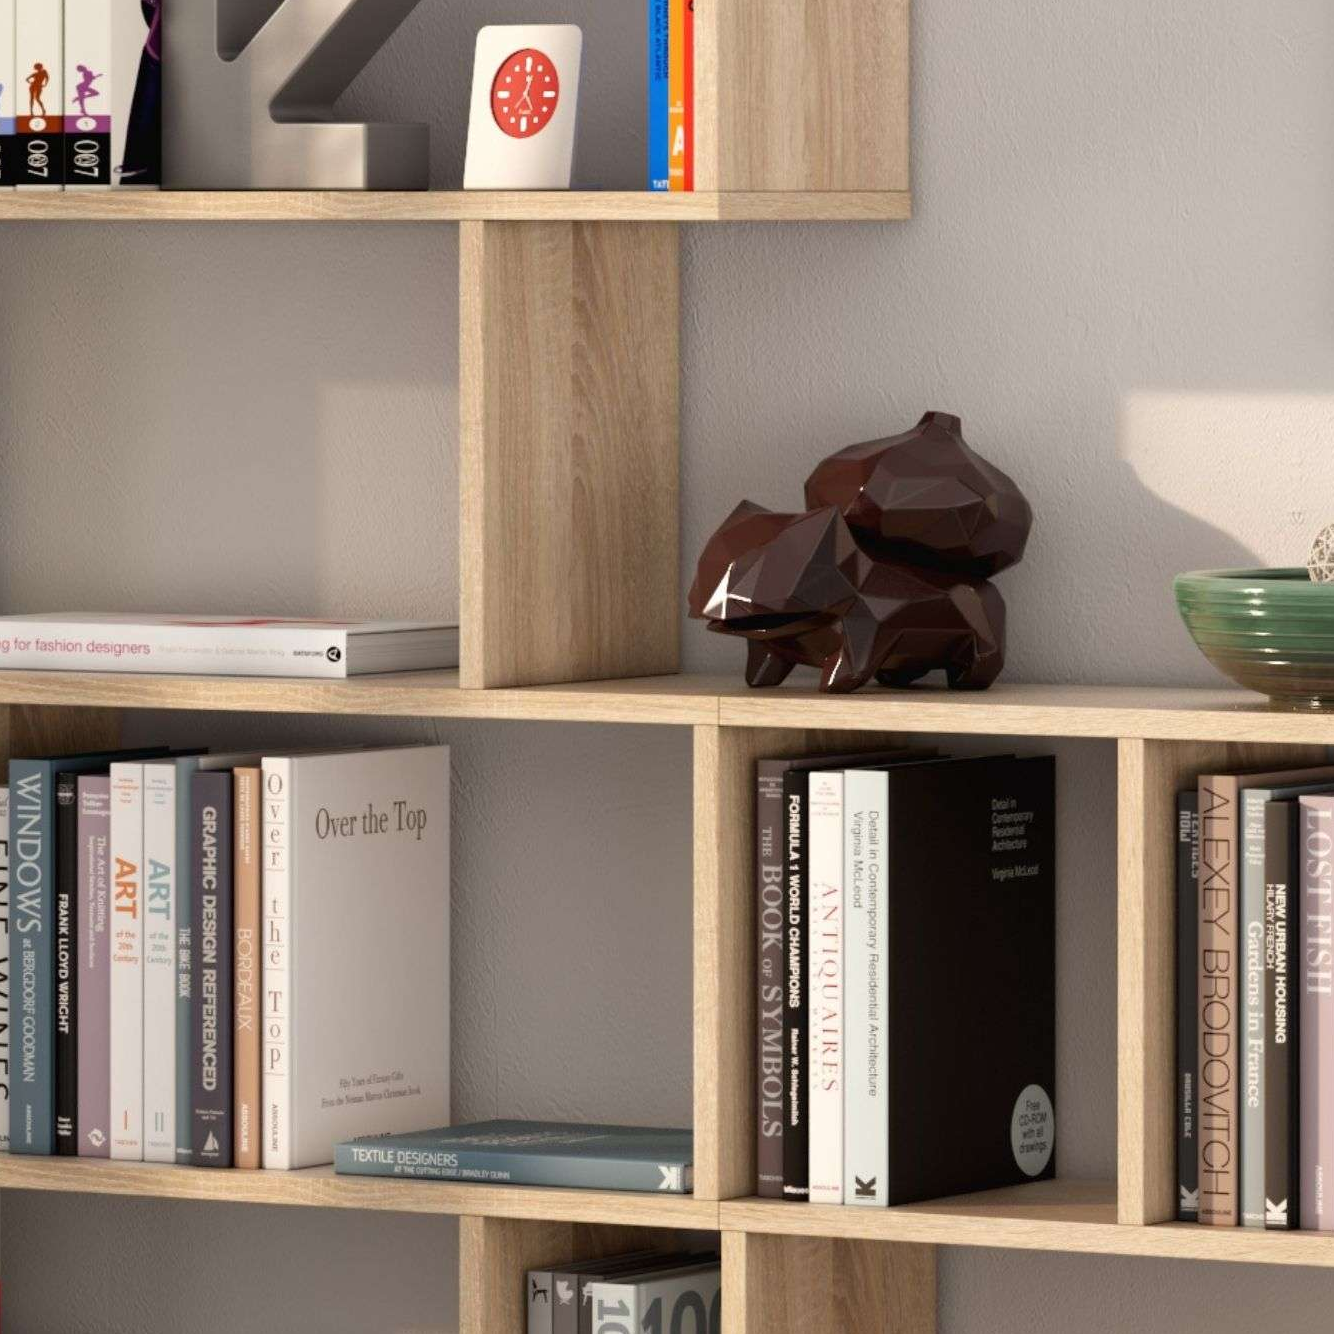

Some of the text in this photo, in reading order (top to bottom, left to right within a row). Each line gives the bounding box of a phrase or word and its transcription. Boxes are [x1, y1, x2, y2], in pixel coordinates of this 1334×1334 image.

[27, 140, 49, 177] 007
[73, 140, 100, 177] 007
[14, 638, 31, 651] for
[35, 638, 83, 653] fashion
[85, 641, 151, 658] designers
[16, 772, 43, 933] WINDOWS
[202, 806, 218, 889] GRAPHIC
[316, 800, 427, 841] Over the Top
[789, 795, 800, 861] FORMULA
[851, 811, 864, 909] Virginia McLeod
[1202, 787, 1231, 936] ALEXEY
[115, 857, 137, 920] ART
[148, 859, 170, 921] ART
[202, 894, 218, 964] DESIGN
[789, 873, 800, 925] WORLD
[1266, 884, 1276, 970] HILARY FRENCH
[1306, 806, 1333, 997] LOST FISH
[58, 893, 70, 1035] FRANK LLOYD WRIGHT
[178, 927, 192, 998] THE BIKE BOOK
[237, 927, 254, 1032] BORDEAUX
[761, 826, 783, 1138] THE BOOK OF SYMBOLS
[789, 927, 800, 1008] CHAMPIONS
[819, 884, 839, 1092] ANTIQUAIRES
[867, 810, 880, 1097] Detail in Contemporary Residential Architecture
[1275, 884, 1287, 1043] NEW URBAN HOUSING
[22, 938, 35, 1082] at BERGDORF GOODMAN
[202, 969, 218, 1091] REFERENCED
[1247, 920, 1265, 1108] Gardens in France
[1202, 949, 1231, 1196] BRODOVITCH
[352, 1148, 459, 1168] TEXTILE DESIGNERS
[1019, 1112, 1047, 1126] CD-ROM
